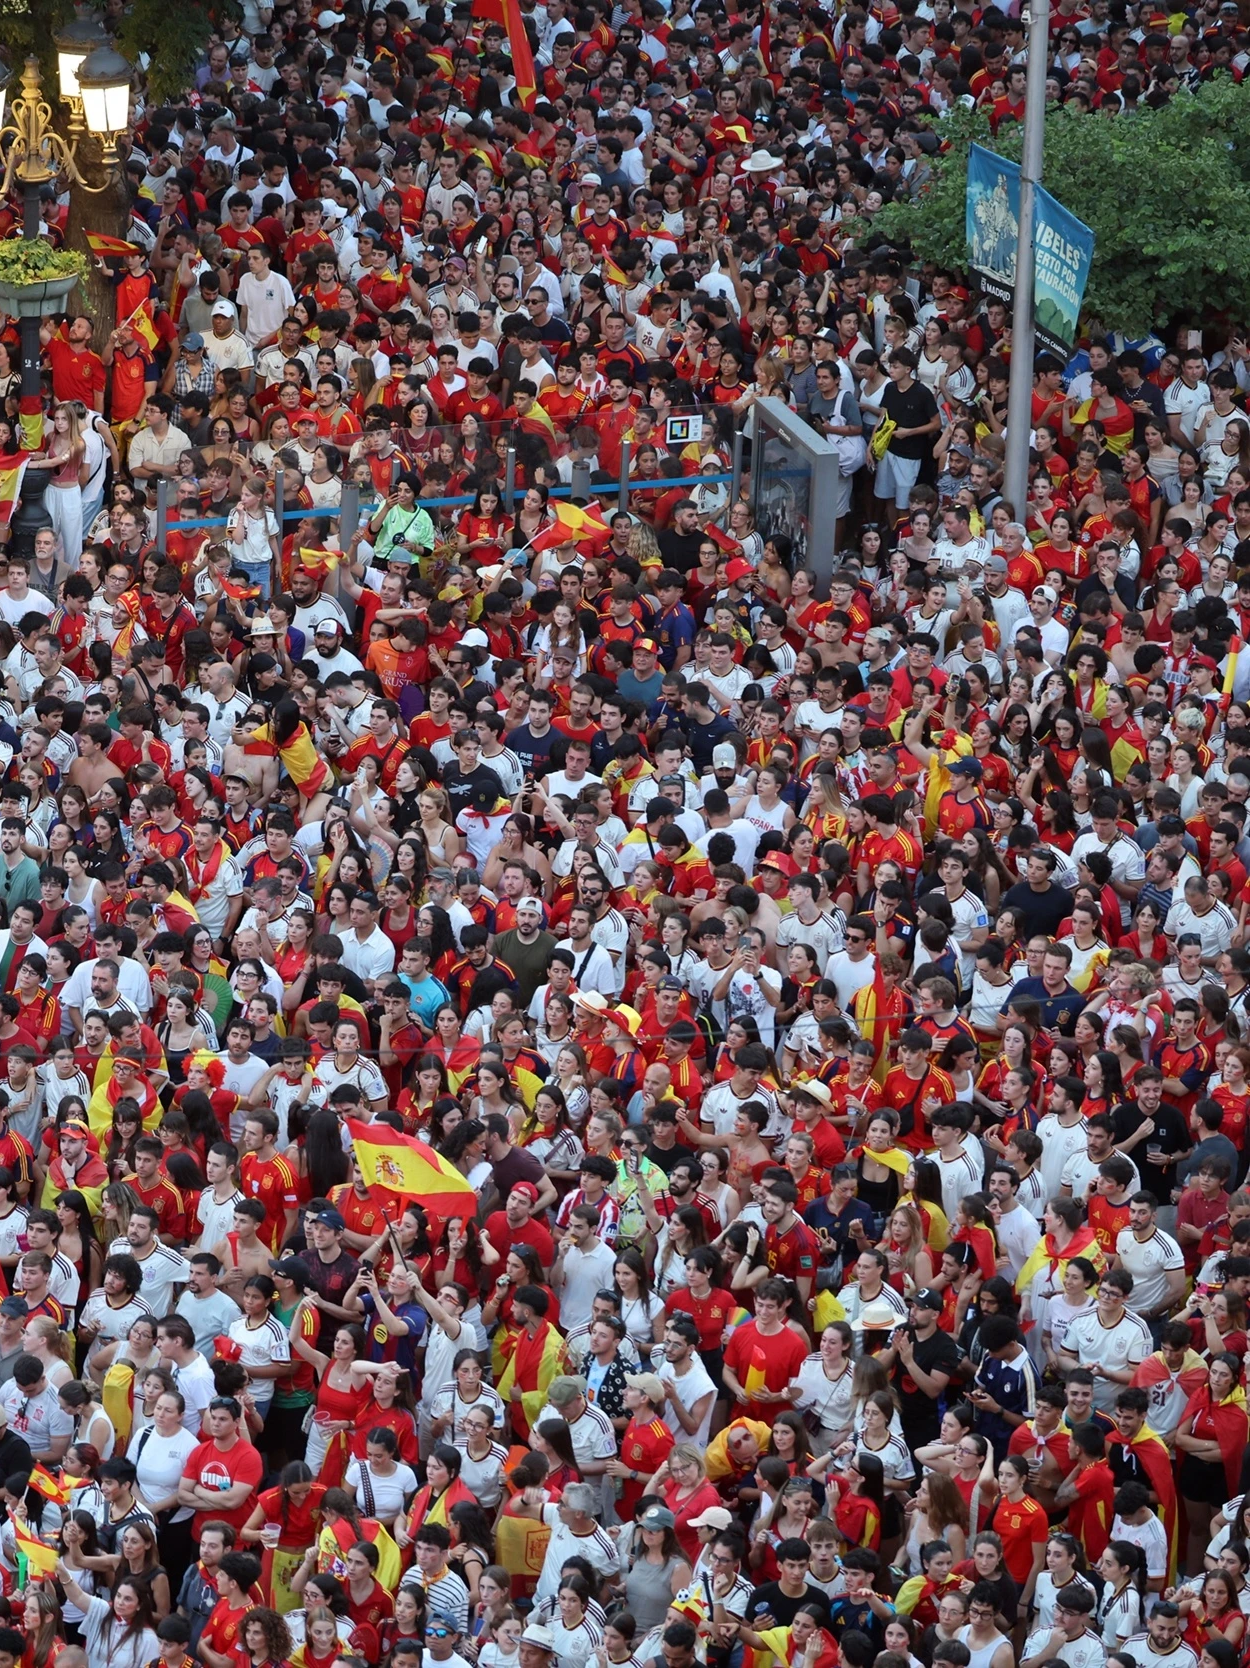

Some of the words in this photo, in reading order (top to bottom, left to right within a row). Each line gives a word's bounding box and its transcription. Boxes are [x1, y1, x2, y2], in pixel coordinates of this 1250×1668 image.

[1036, 220, 1080, 270] ÍBELES
[1035, 247, 1061, 273] ERTO
[1061, 265, 1077, 287] POR
[986, 283, 1011, 302] MADRID
[642, 334, 653, 347] 26
[1042, 336, 1050, 345] LOS
[599, 419, 605, 431] 9
[181, 561, 188, 574] 8
[382, 669, 408, 679] GRAND
[701, 990, 708, 1004] 8
[1096, 1228, 1111, 1246] 20
[767, 1250, 776, 1270] 15
[1152, 1391, 1165, 1407] 21
